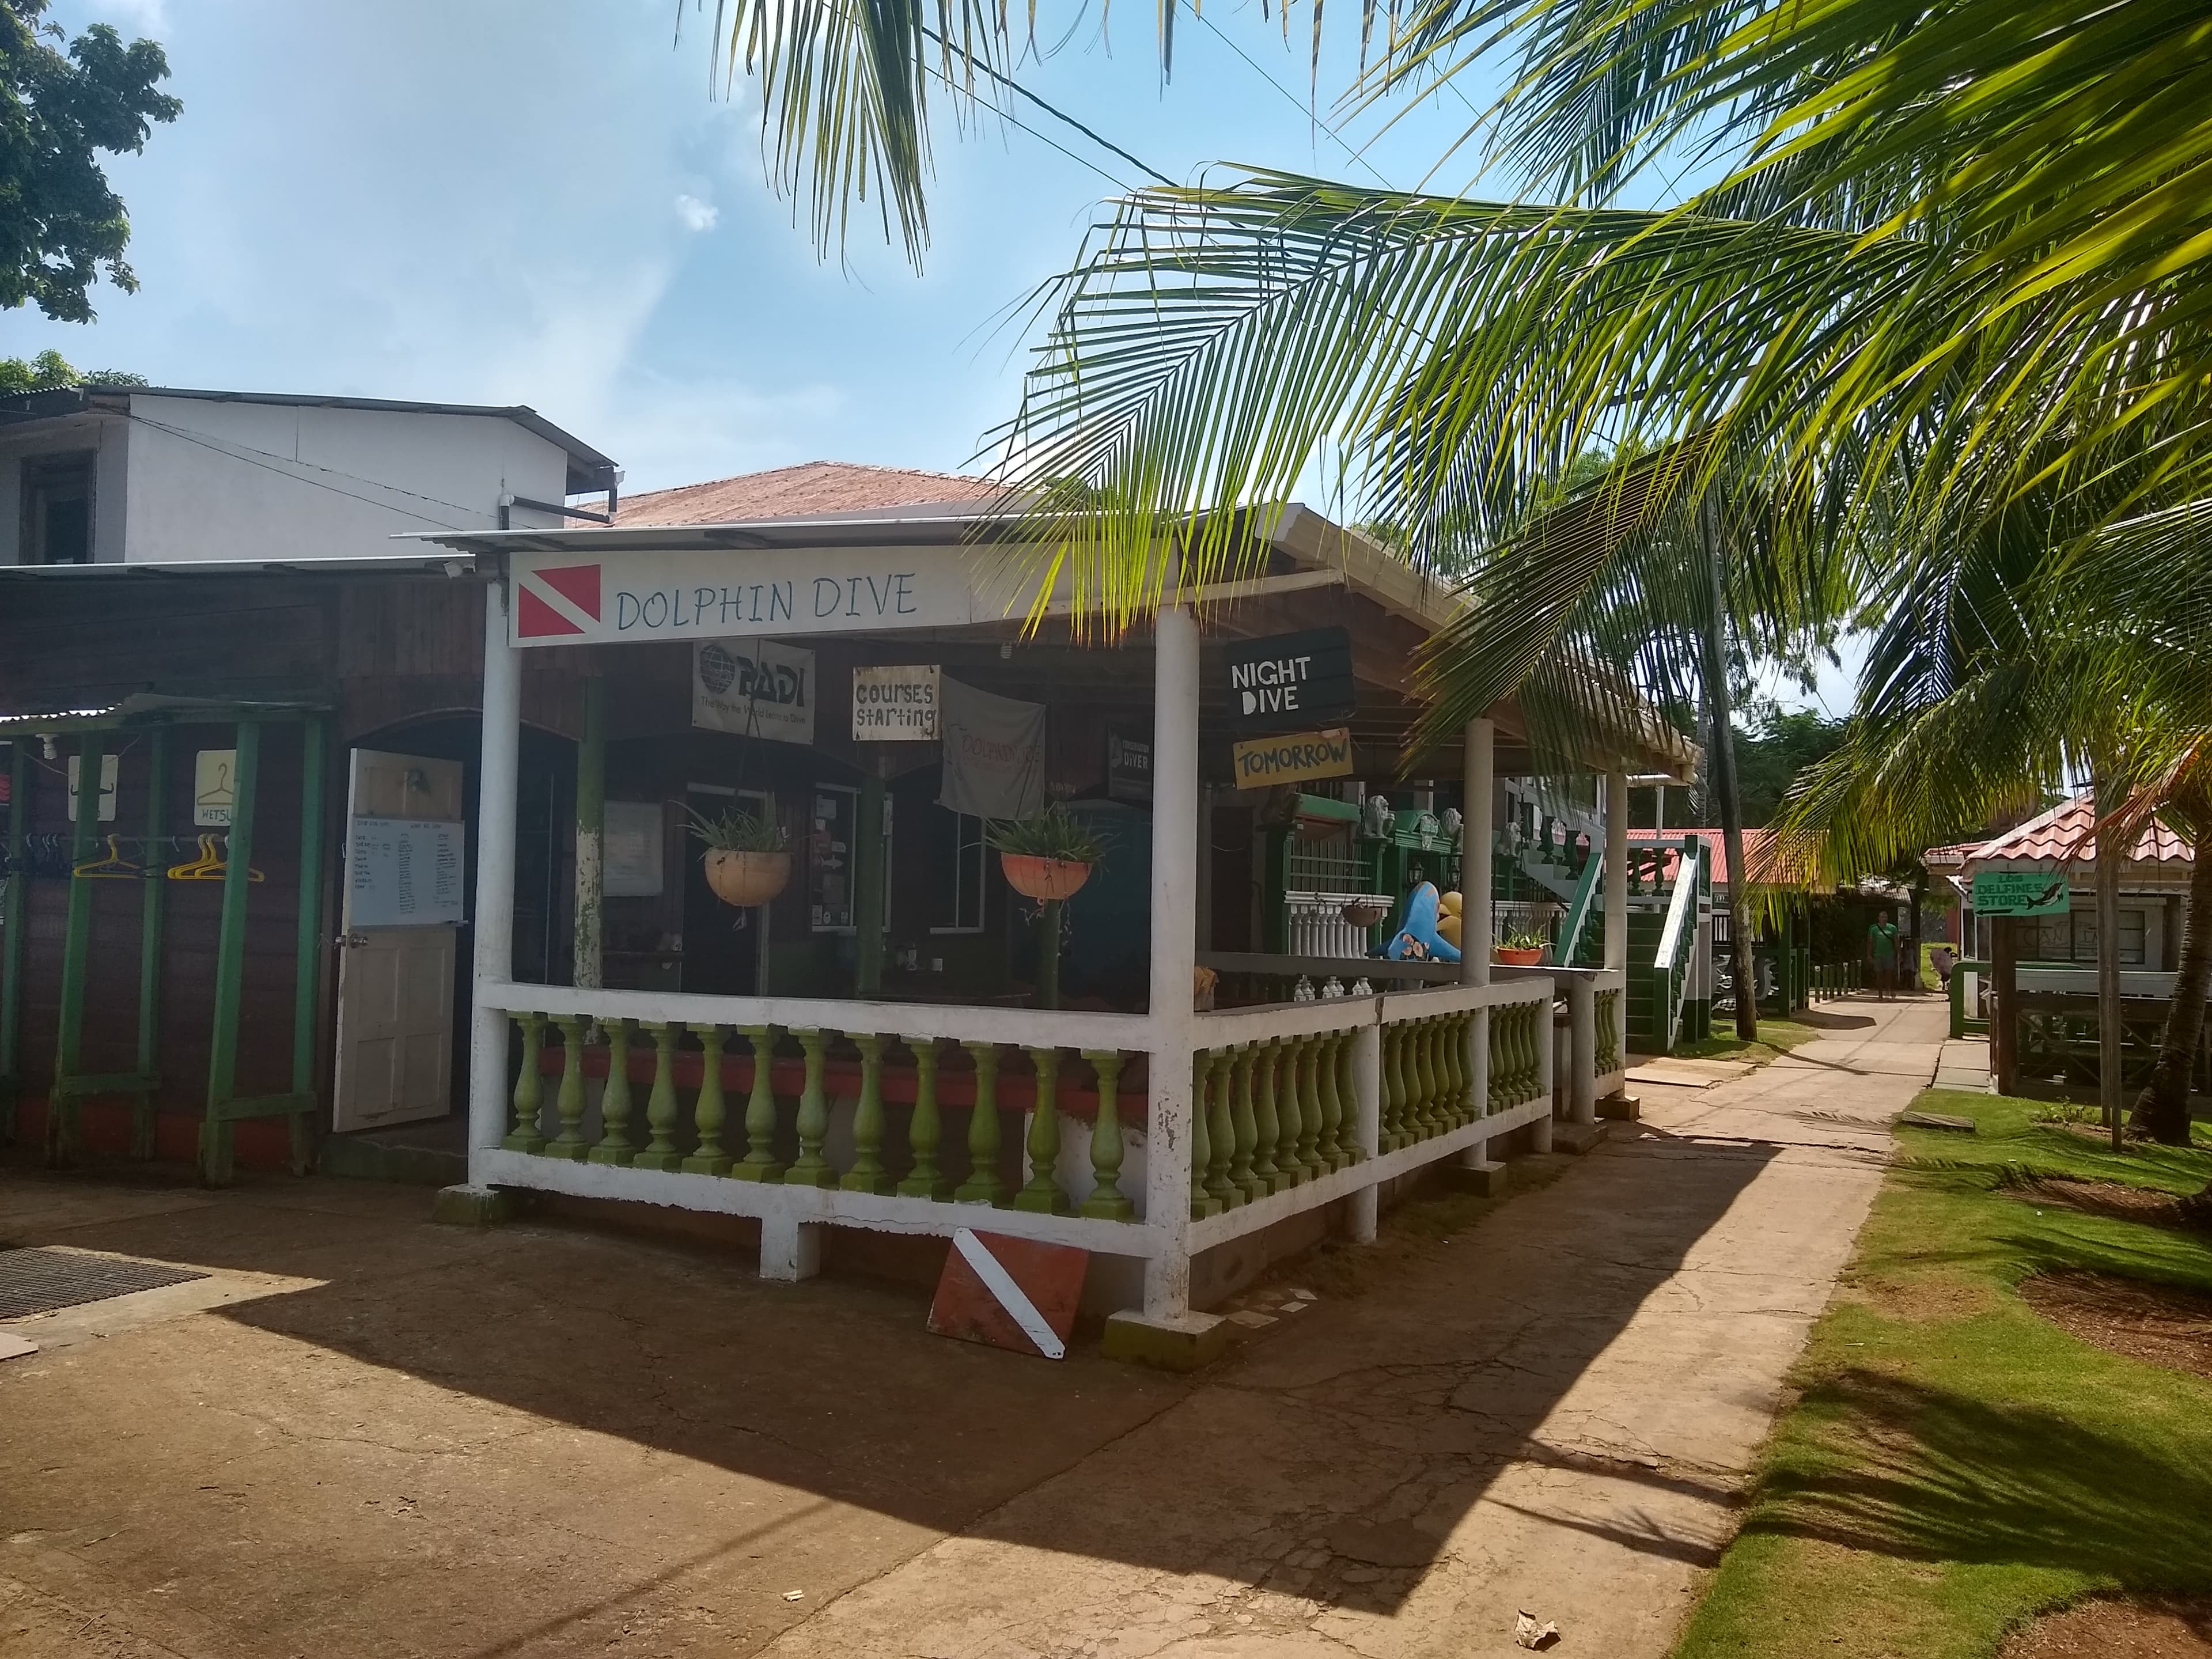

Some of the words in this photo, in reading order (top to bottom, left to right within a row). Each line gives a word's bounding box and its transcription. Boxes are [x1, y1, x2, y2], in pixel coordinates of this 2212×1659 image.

[618, 581, 793, 631] DOLPHIN
[813, 573, 918, 618] DIVE
[737, 656, 805, 707] PADI
[1232, 656, 1311, 688] NIGHT
[1242, 685, 1299, 715] DIVE
[1238, 738, 1347, 777] TOMORROW
[1976, 884, 2043, 895] DELFINES
[1998, 875, 2024, 883] LOS
[1978, 895, 2028, 906] STORE
